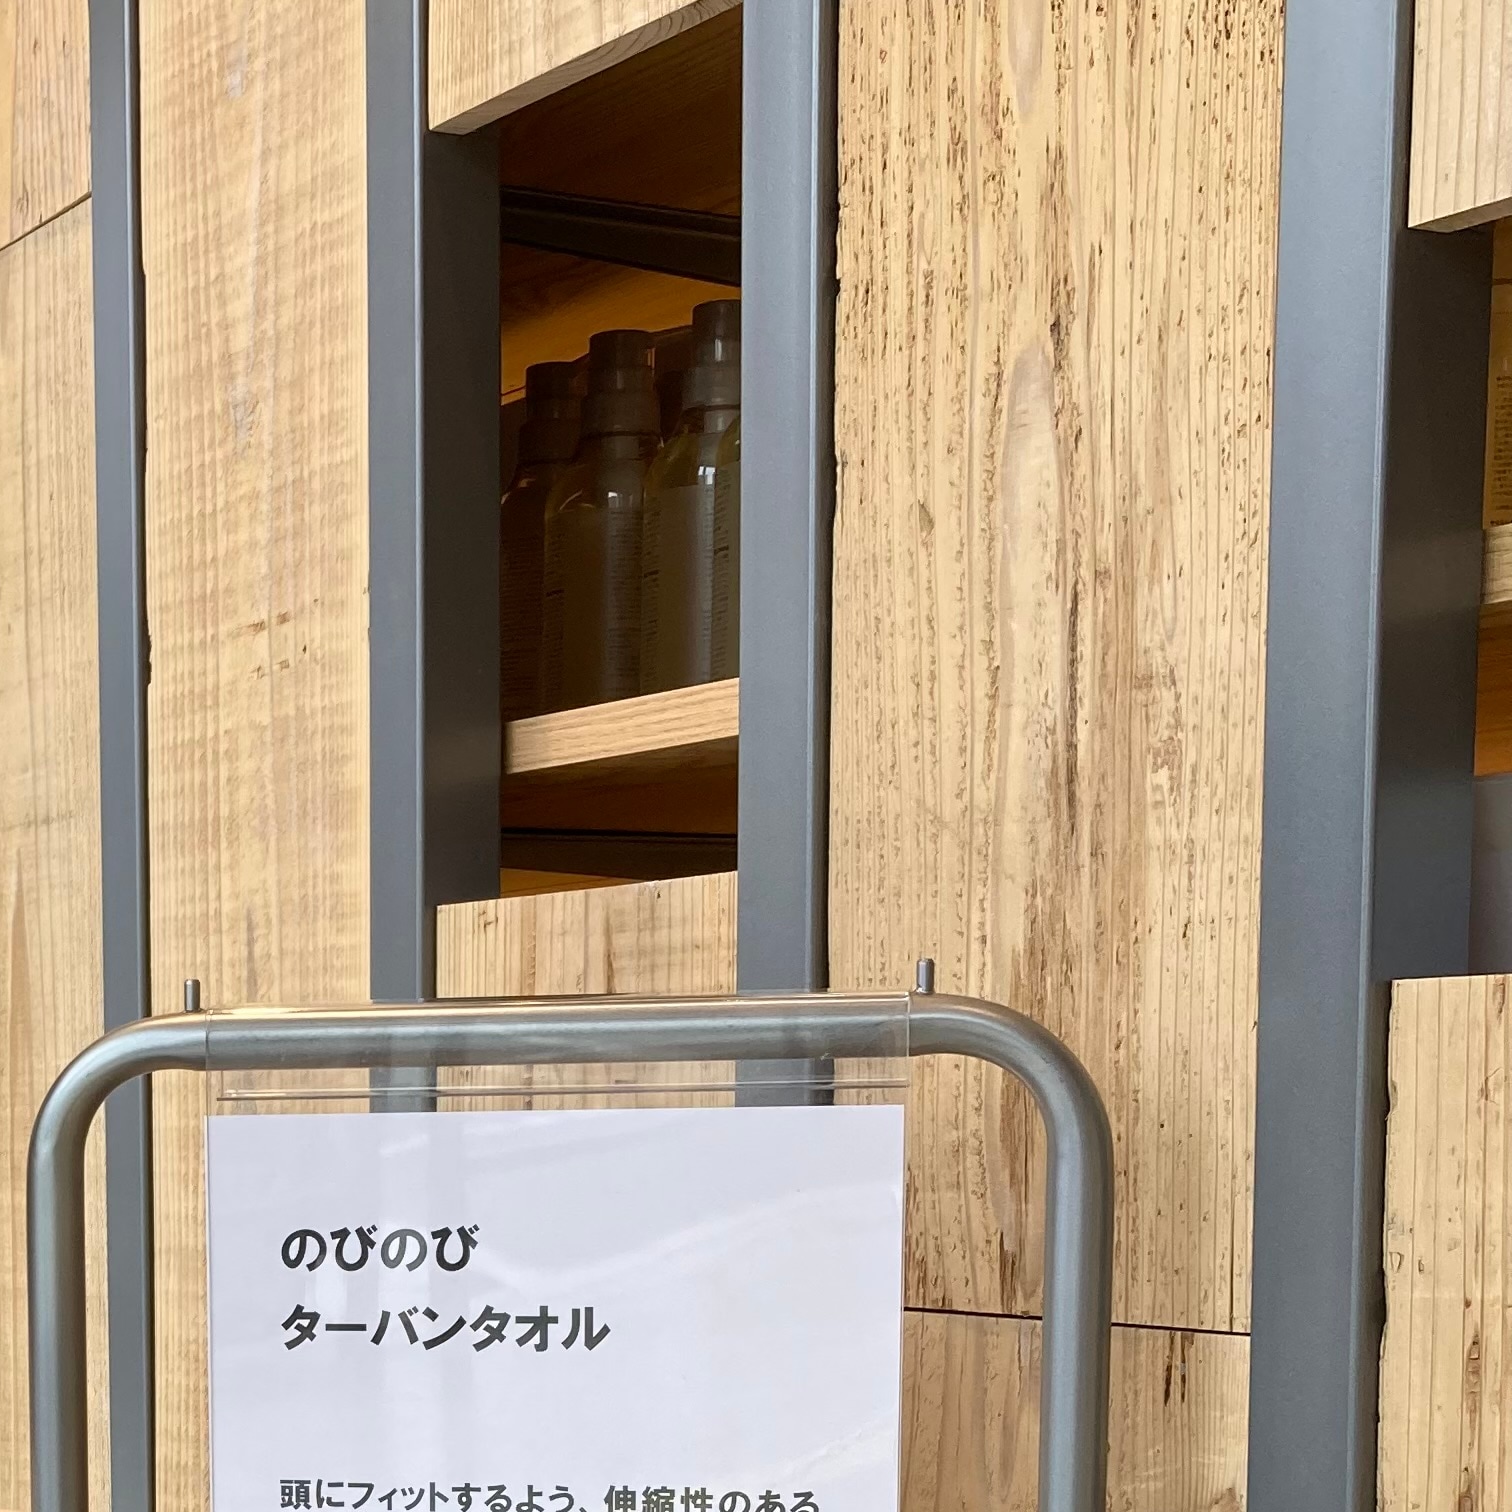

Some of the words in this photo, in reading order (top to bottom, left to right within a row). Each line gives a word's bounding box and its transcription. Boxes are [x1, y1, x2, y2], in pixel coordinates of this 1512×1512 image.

[281, 1225, 480, 1272] のびのび
[281, 1304, 611, 1352] ターバンタオル
